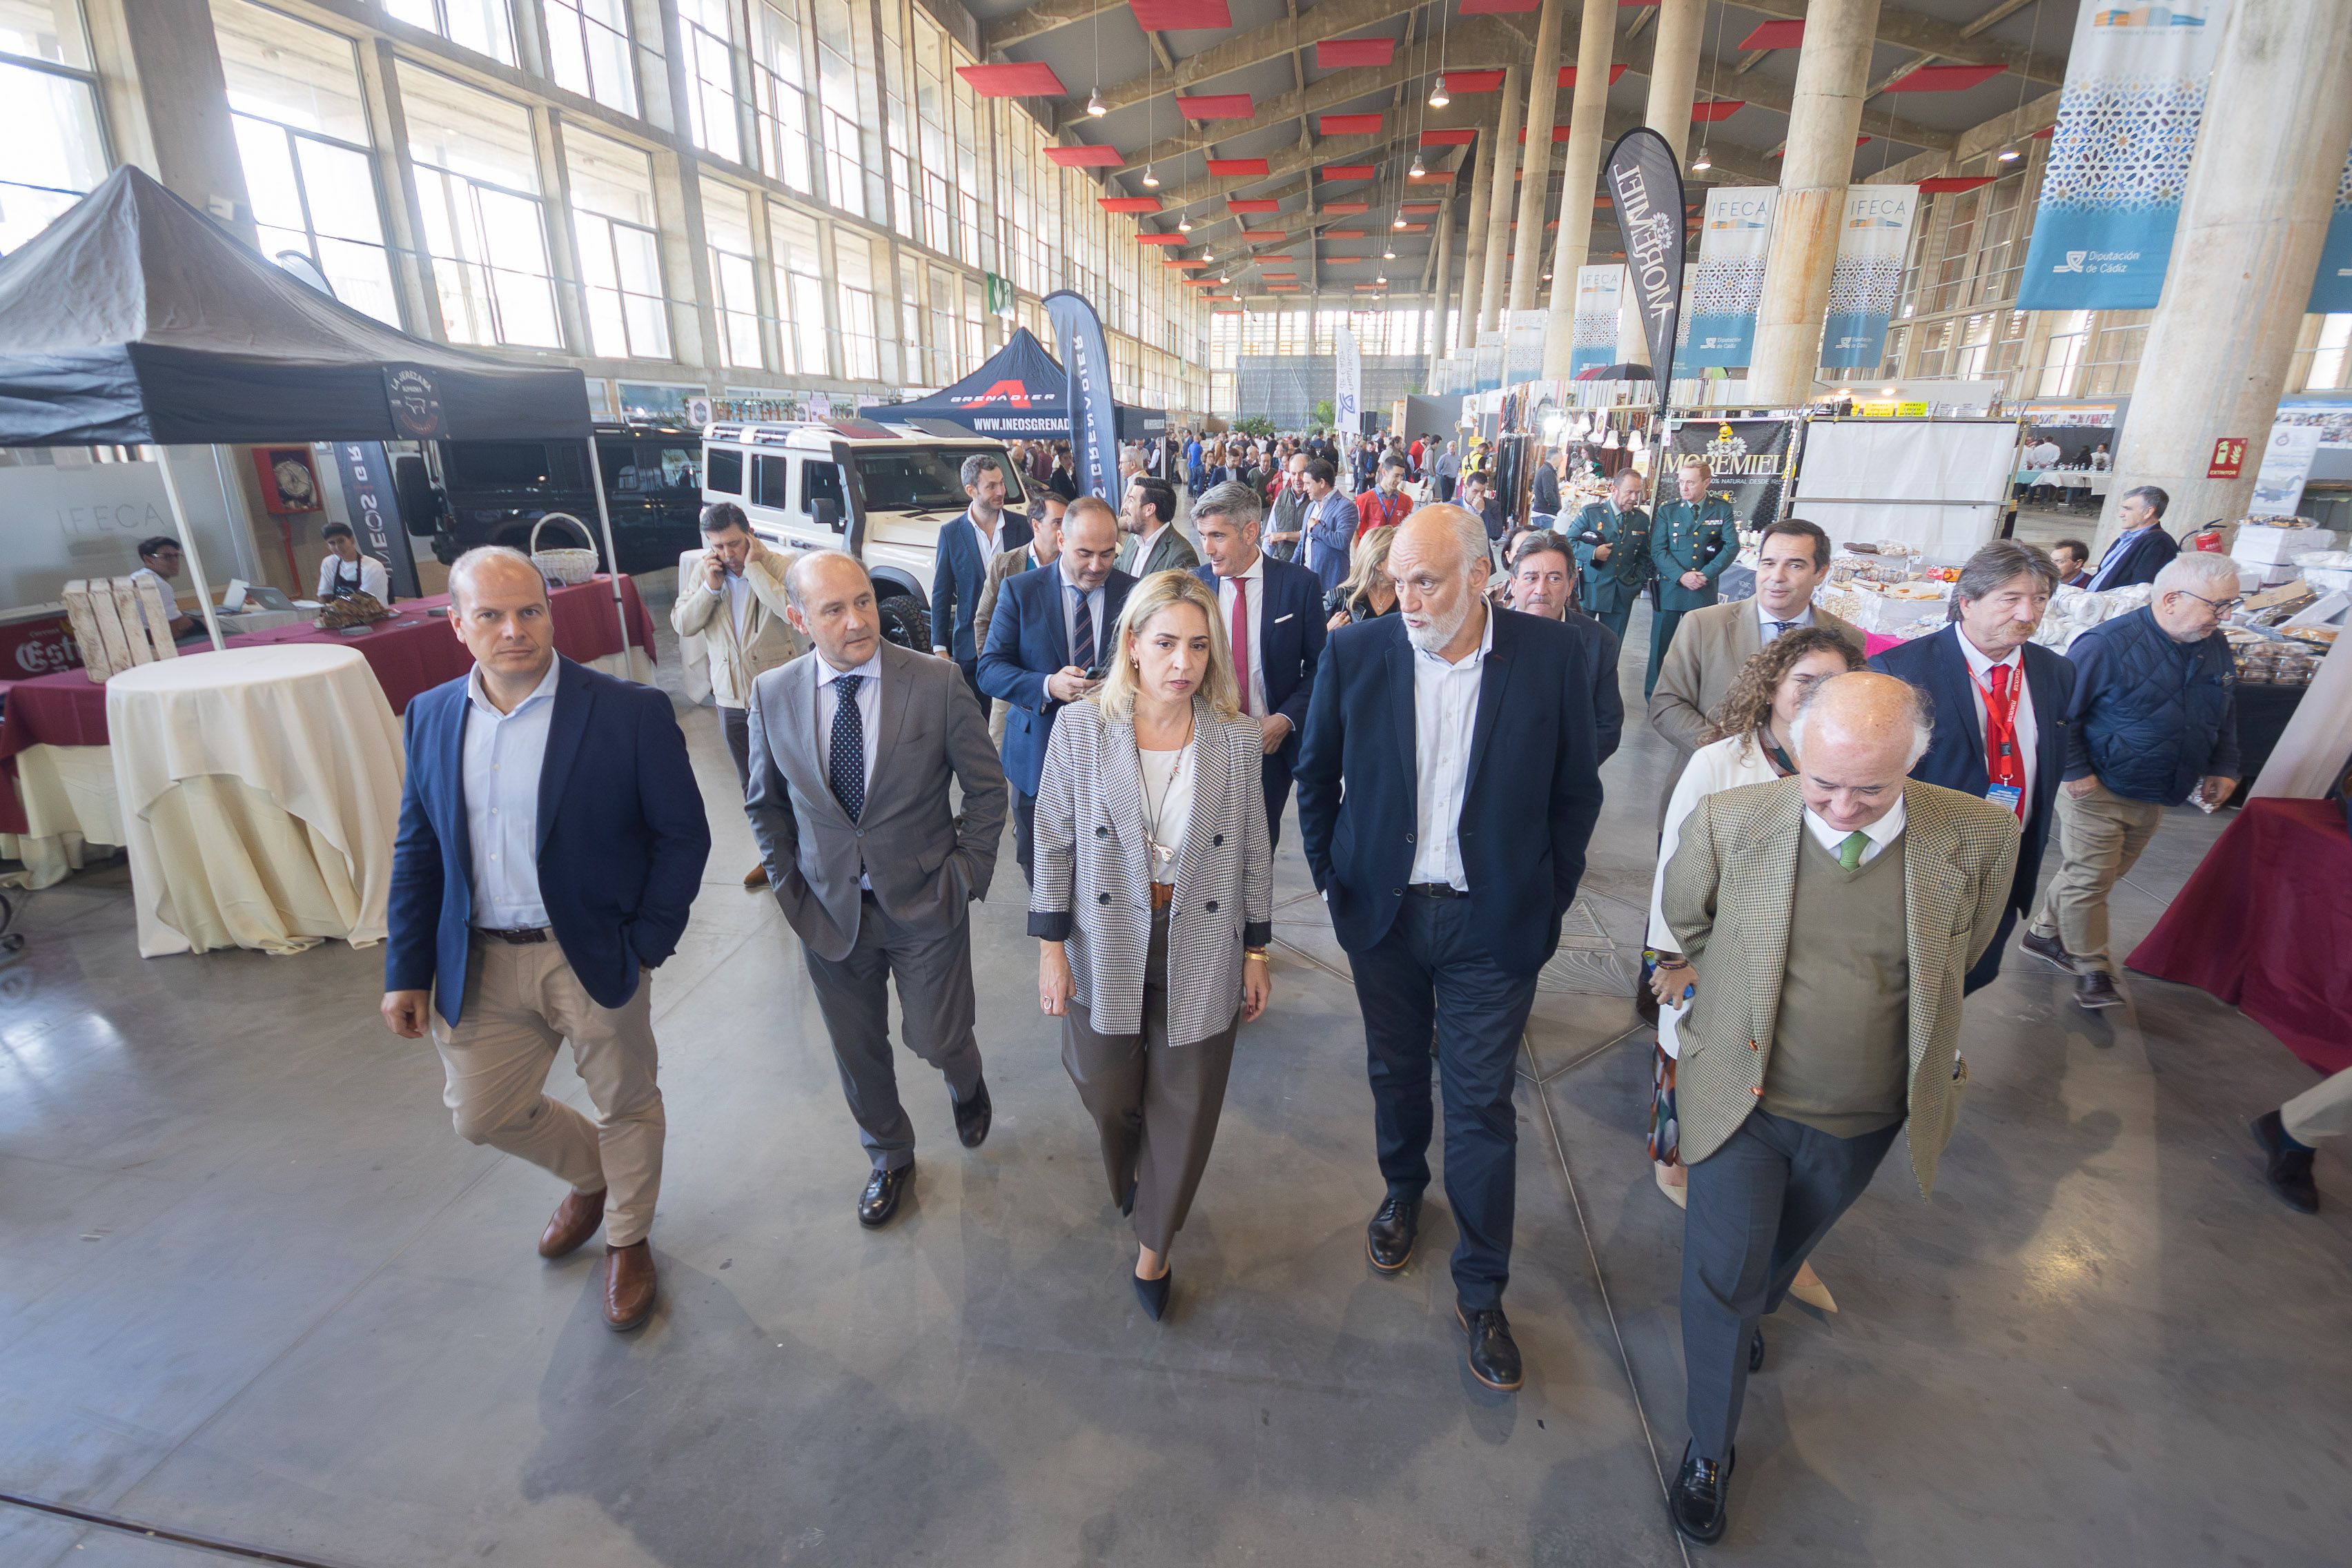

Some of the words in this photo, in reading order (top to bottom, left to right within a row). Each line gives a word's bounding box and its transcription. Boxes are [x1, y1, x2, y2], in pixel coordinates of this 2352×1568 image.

[1712, 201, 1767, 217] IFECA
[1850, 199, 1905, 215] IFECA
[2088, 250, 2140, 262] Diputación
[2086, 264, 2097, 273] de
[2100, 262, 2128, 273] Cádiz
[1582, 274, 1618, 285] IFECA
[950, 393, 1055, 402] GRENADIER
[974, 418, 1070, 431] WWW.INEOSGRENAD
[55, 502, 166, 535] IFECA
